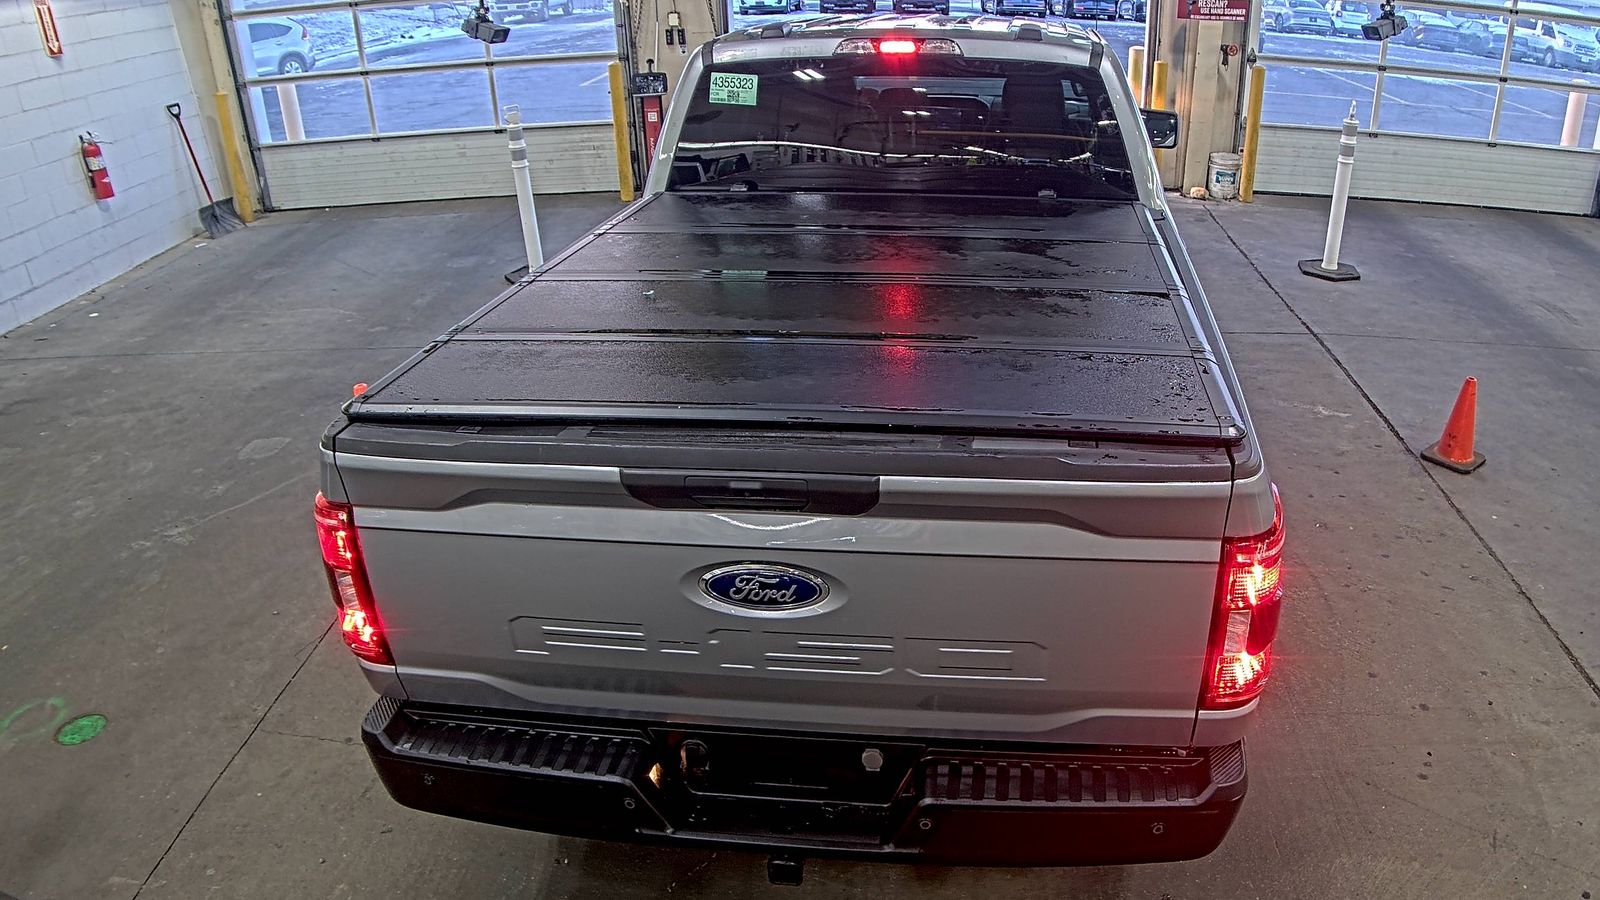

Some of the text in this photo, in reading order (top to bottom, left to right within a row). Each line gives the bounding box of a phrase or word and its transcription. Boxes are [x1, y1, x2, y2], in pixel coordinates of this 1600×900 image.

[712, 76, 754, 90] 4355323
[728, 573, 798, 604] Ford
[509, 615, 1049, 682] F-150
